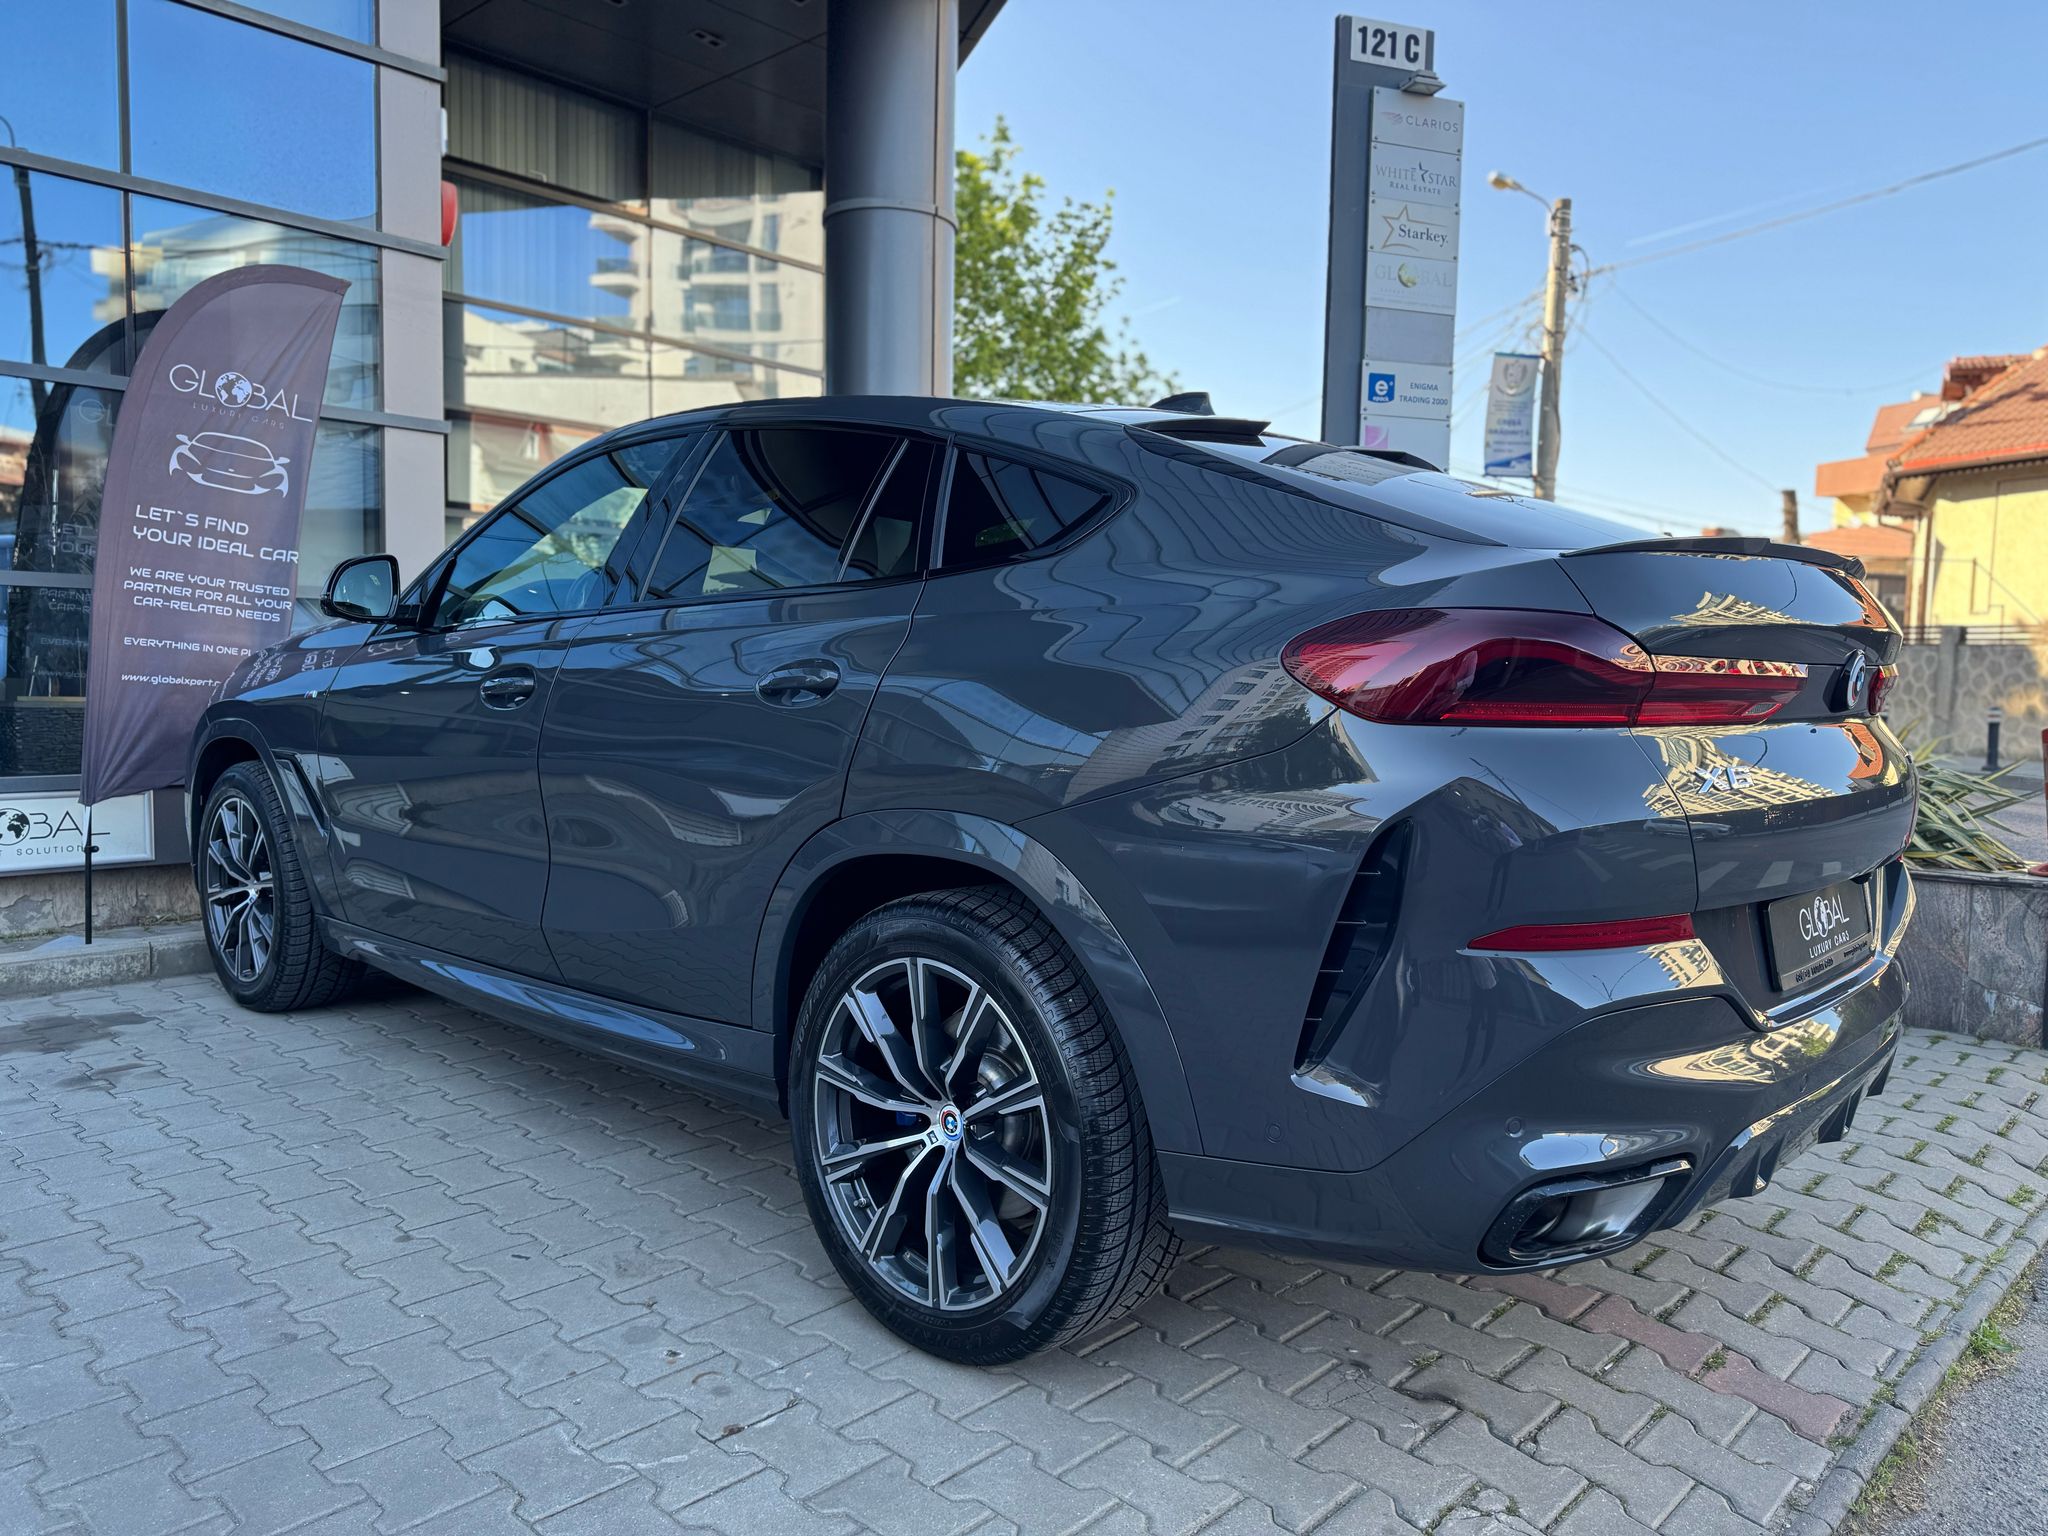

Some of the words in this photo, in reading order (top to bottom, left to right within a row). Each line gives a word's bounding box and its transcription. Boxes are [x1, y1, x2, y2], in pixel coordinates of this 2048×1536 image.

[1358, 25, 1398, 60] 121
[1404, 33, 1420, 63] C
[1405, 114, 1459, 133] CLARIOS
[1375, 164, 1417, 181] WHITE
[1428, 171, 1457, 188] STAR
[1389, 180, 1410, 191] REAL
[1413, 182, 1441, 195] ESTATE
[169, 363, 313, 423] GLOBAL
[1399, 394, 1431, 405] TRADING
[1431, 397, 1449, 406] 2000
[1409, 382, 1439, 391] ENIGMA
[204, 516, 249, 536] FIND
[132, 525, 192, 547] YOUR
[198, 535, 254, 558] IDEAL
[259, 546, 299, 564] CAR
[123, 580, 192, 598] PARTNER
[195, 589, 223, 602] FOR
[225, 593, 252, 606] ALL
[254, 597, 293, 611] YOUR
[129, 566, 152, 578] WE
[154, 570, 185, 582] ARE
[187, 573, 226, 589] YOUR
[228, 579, 290, 597] TRUSTED
[133, 595, 233, 617] CAR-RELATED
[235, 608, 281, 622] NEEDS
[123, 636, 201, 651] EVERYTHING
[202, 643, 214, 653] IN
[216, 645, 239, 656] ONE
[1694, 765, 1755, 794] X6
[1799, 892, 1850, 941] GLOBAL
[1808, 938, 1833, 959] LUXURY
[1833, 930, 1850, 946] CARS
